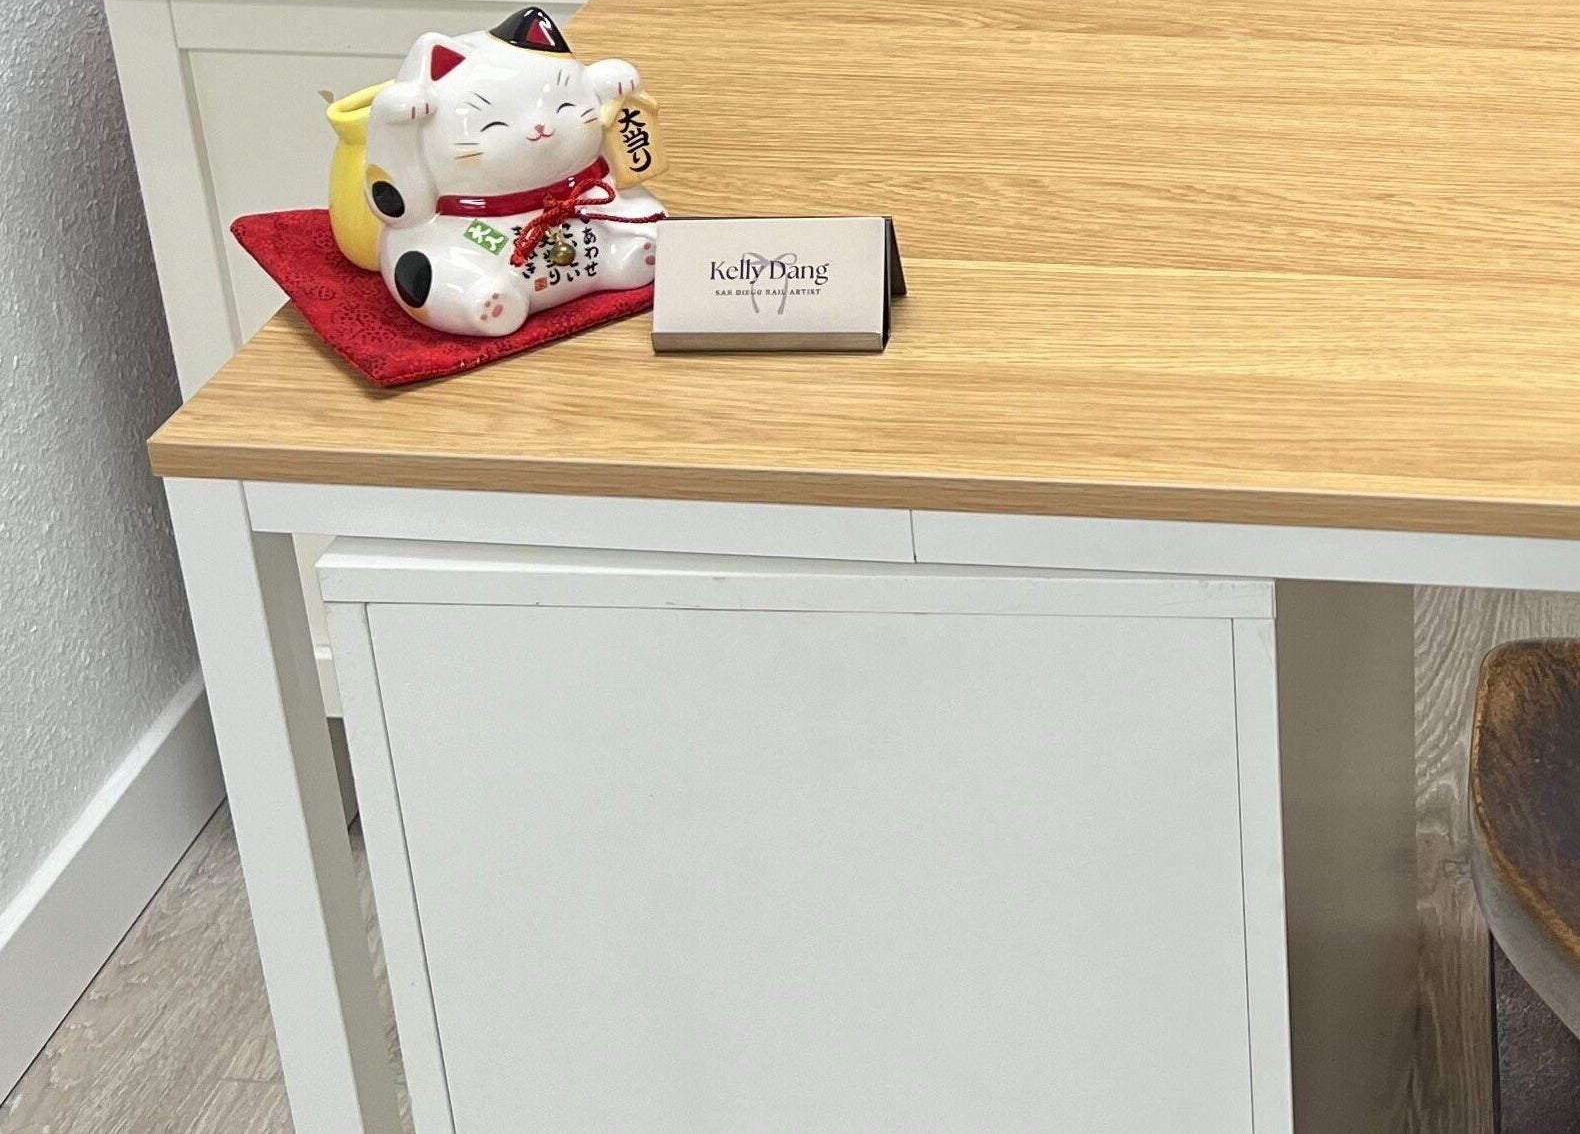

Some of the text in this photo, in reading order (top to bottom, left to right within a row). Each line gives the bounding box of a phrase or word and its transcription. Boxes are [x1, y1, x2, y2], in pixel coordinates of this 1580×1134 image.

[617, 108, 652, 173] 大当り
[710, 258, 830, 286] Kelly Dang
